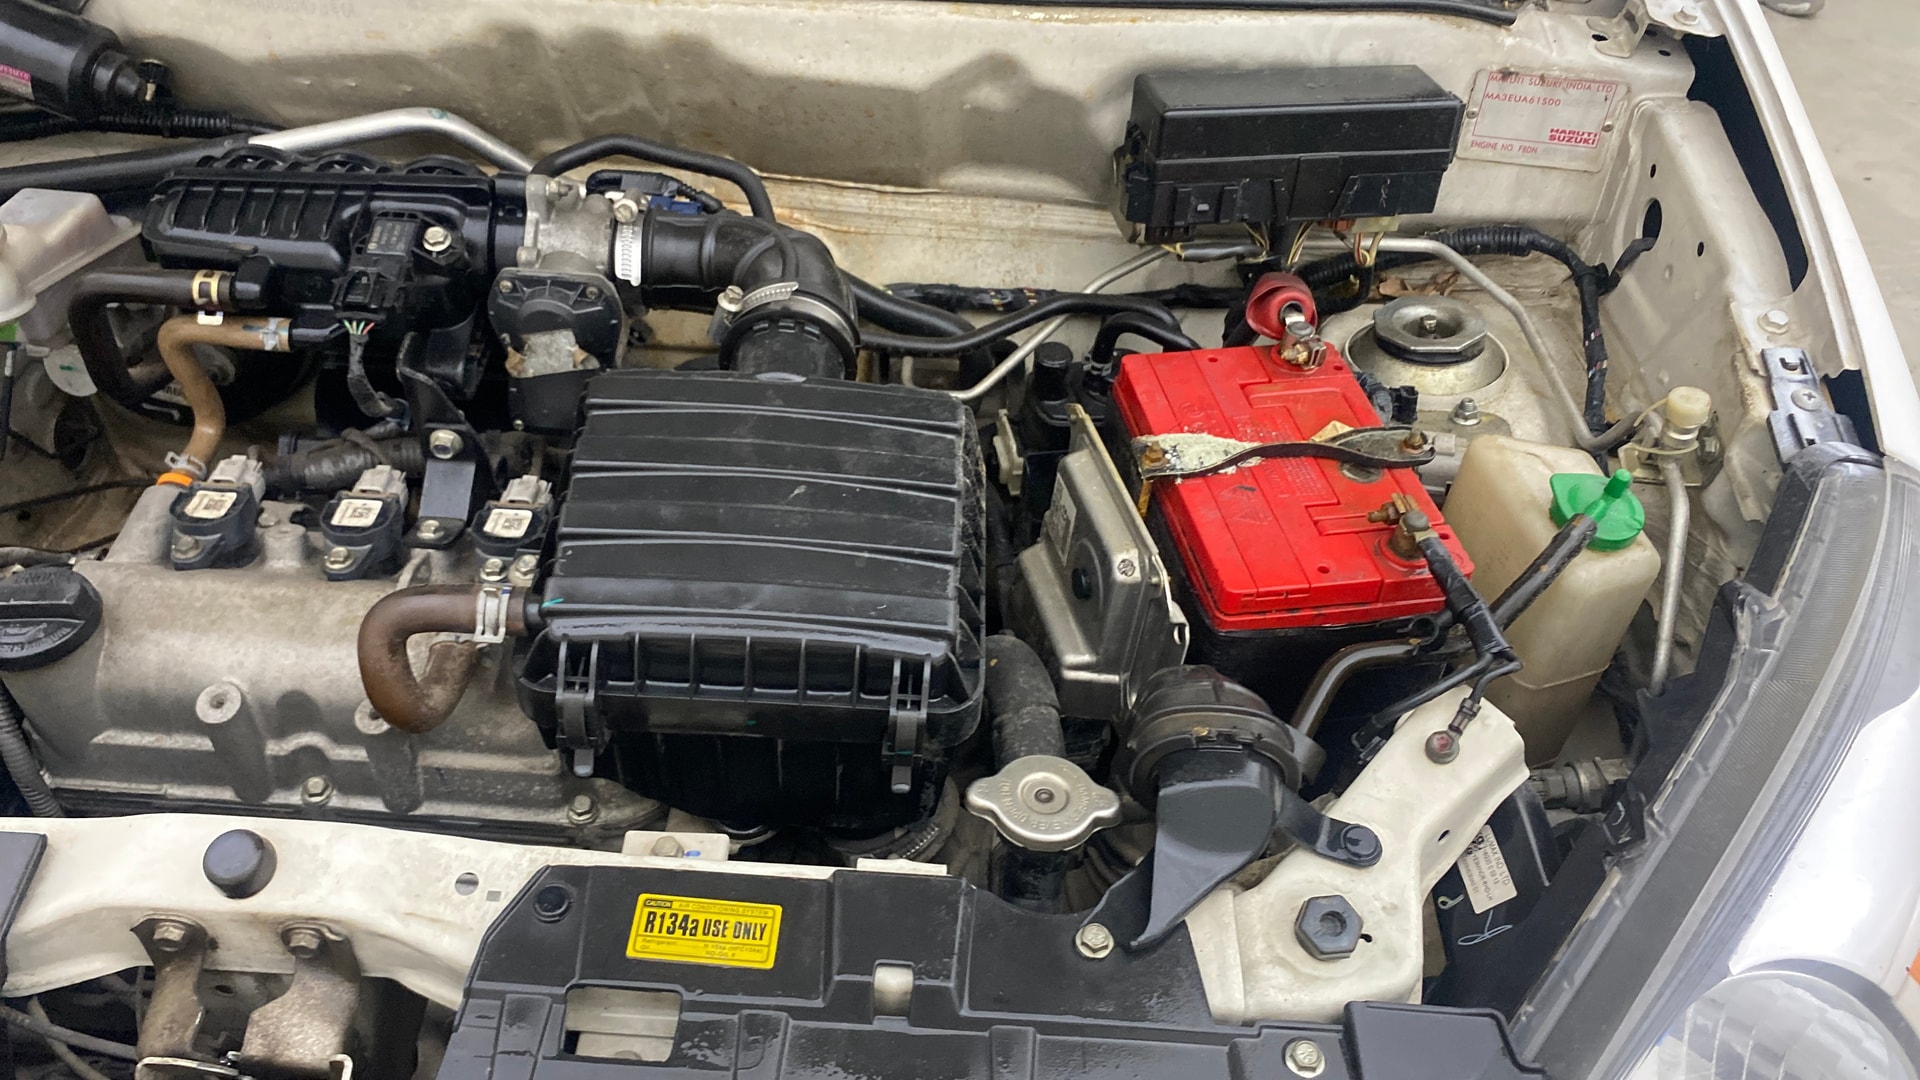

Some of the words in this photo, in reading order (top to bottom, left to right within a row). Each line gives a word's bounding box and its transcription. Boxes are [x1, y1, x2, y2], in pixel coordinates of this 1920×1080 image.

[1489, 73, 1525, 85] MARUTI
[1528, 77, 1562, 88] SUZUKI
[1566, 81, 1592, 91] INDIA
[1596, 84, 1613, 93] LTD
[1549, 128, 1598, 138] MARUTI
[1548, 134, 1597, 145] SUZUKI
[1471, 140, 1498, 150] ENGINE
[1501, 144, 1514, 152] NO
[644, 911, 699, 937] R134a
[702, 918, 729, 938] USE
[732, 921, 768, 941] ONLY
